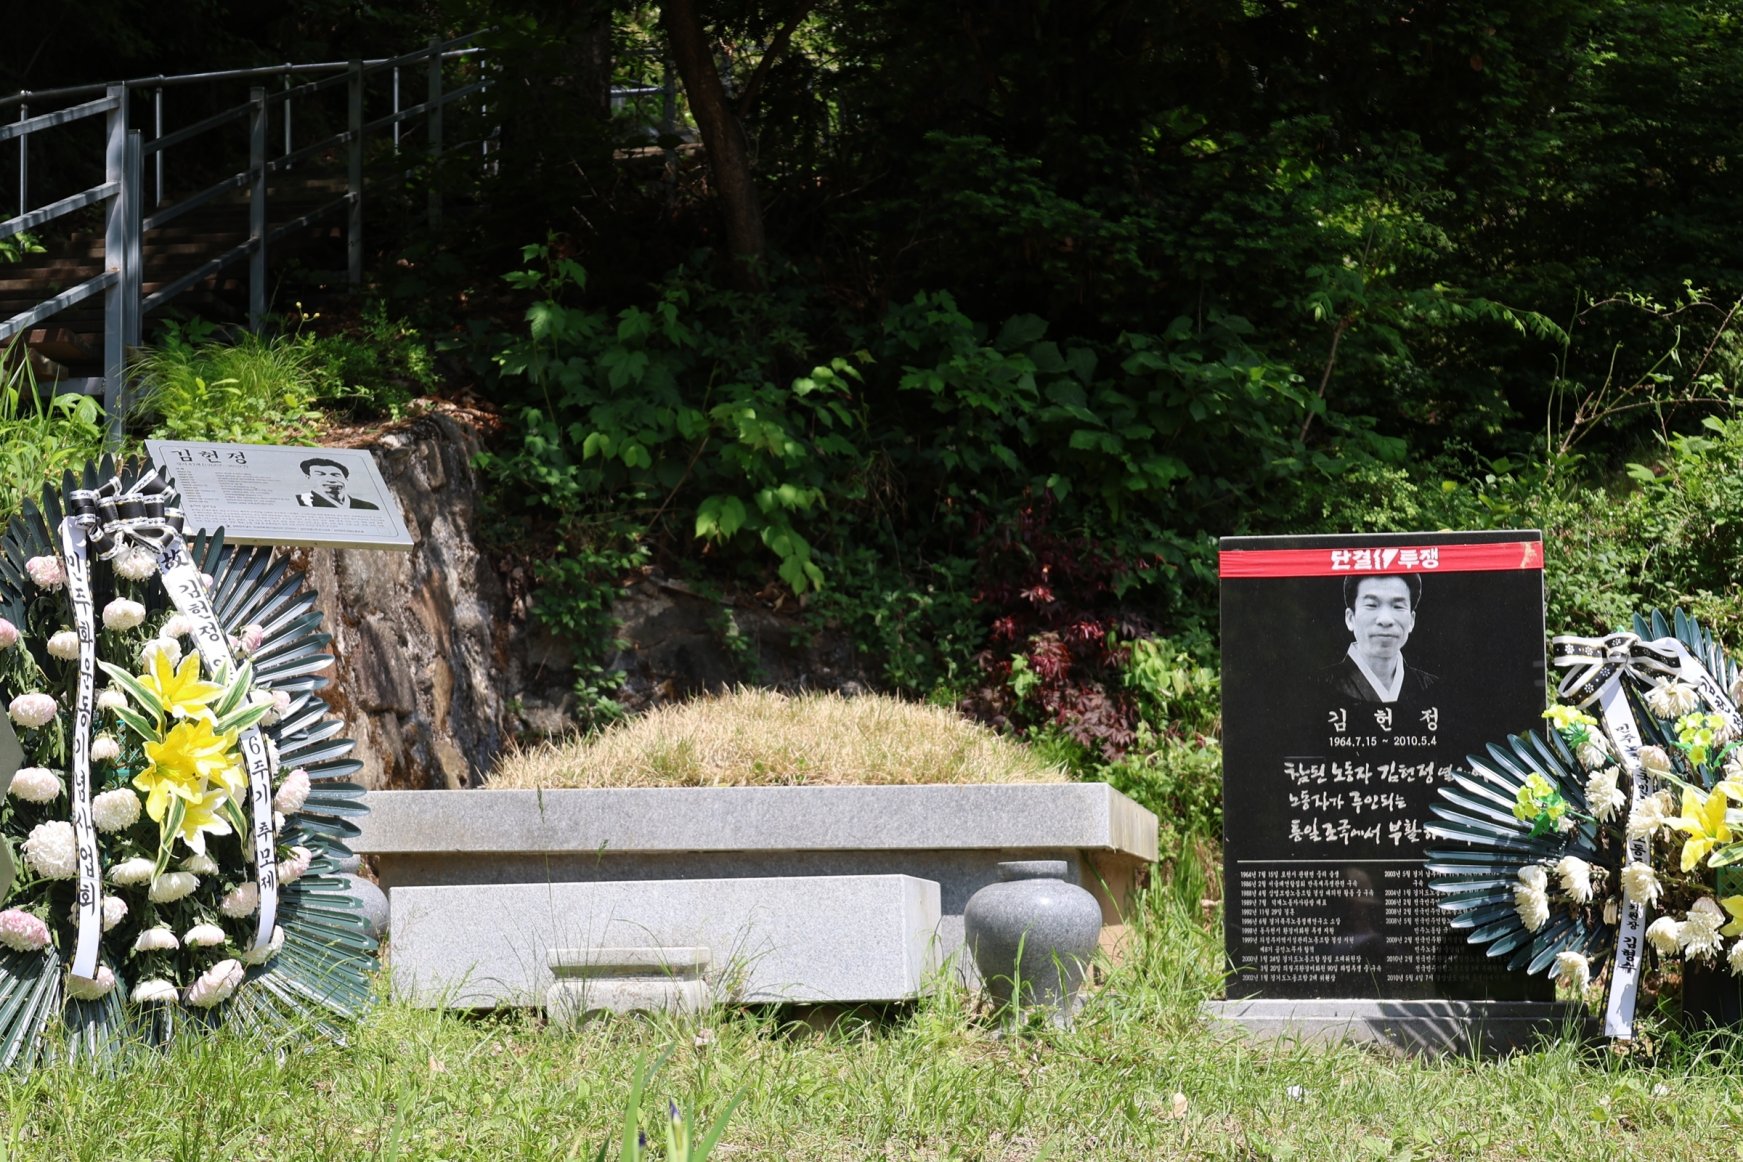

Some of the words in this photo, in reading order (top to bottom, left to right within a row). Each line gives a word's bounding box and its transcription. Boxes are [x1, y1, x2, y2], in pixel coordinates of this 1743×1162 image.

[161, 549, 189, 570] 故
[1331, 549, 1374, 570] 단결
[1398, 546, 1439, 568] 투쟁
[178, 579, 220, 642] 김헌정
[1329, 737, 1377, 747] 1964.7.15
[1393, 736, 1438, 746] 2010.5.4
[245, 727, 268, 805] 6주기
[1283, 761, 1328, 785] 참된
[1332, 761, 1373, 784] 노동자
[1289, 790, 1345, 811] 노동자가
[1349, 790, 1407, 813] 주인되는
[256, 822, 275, 891] 추모제
